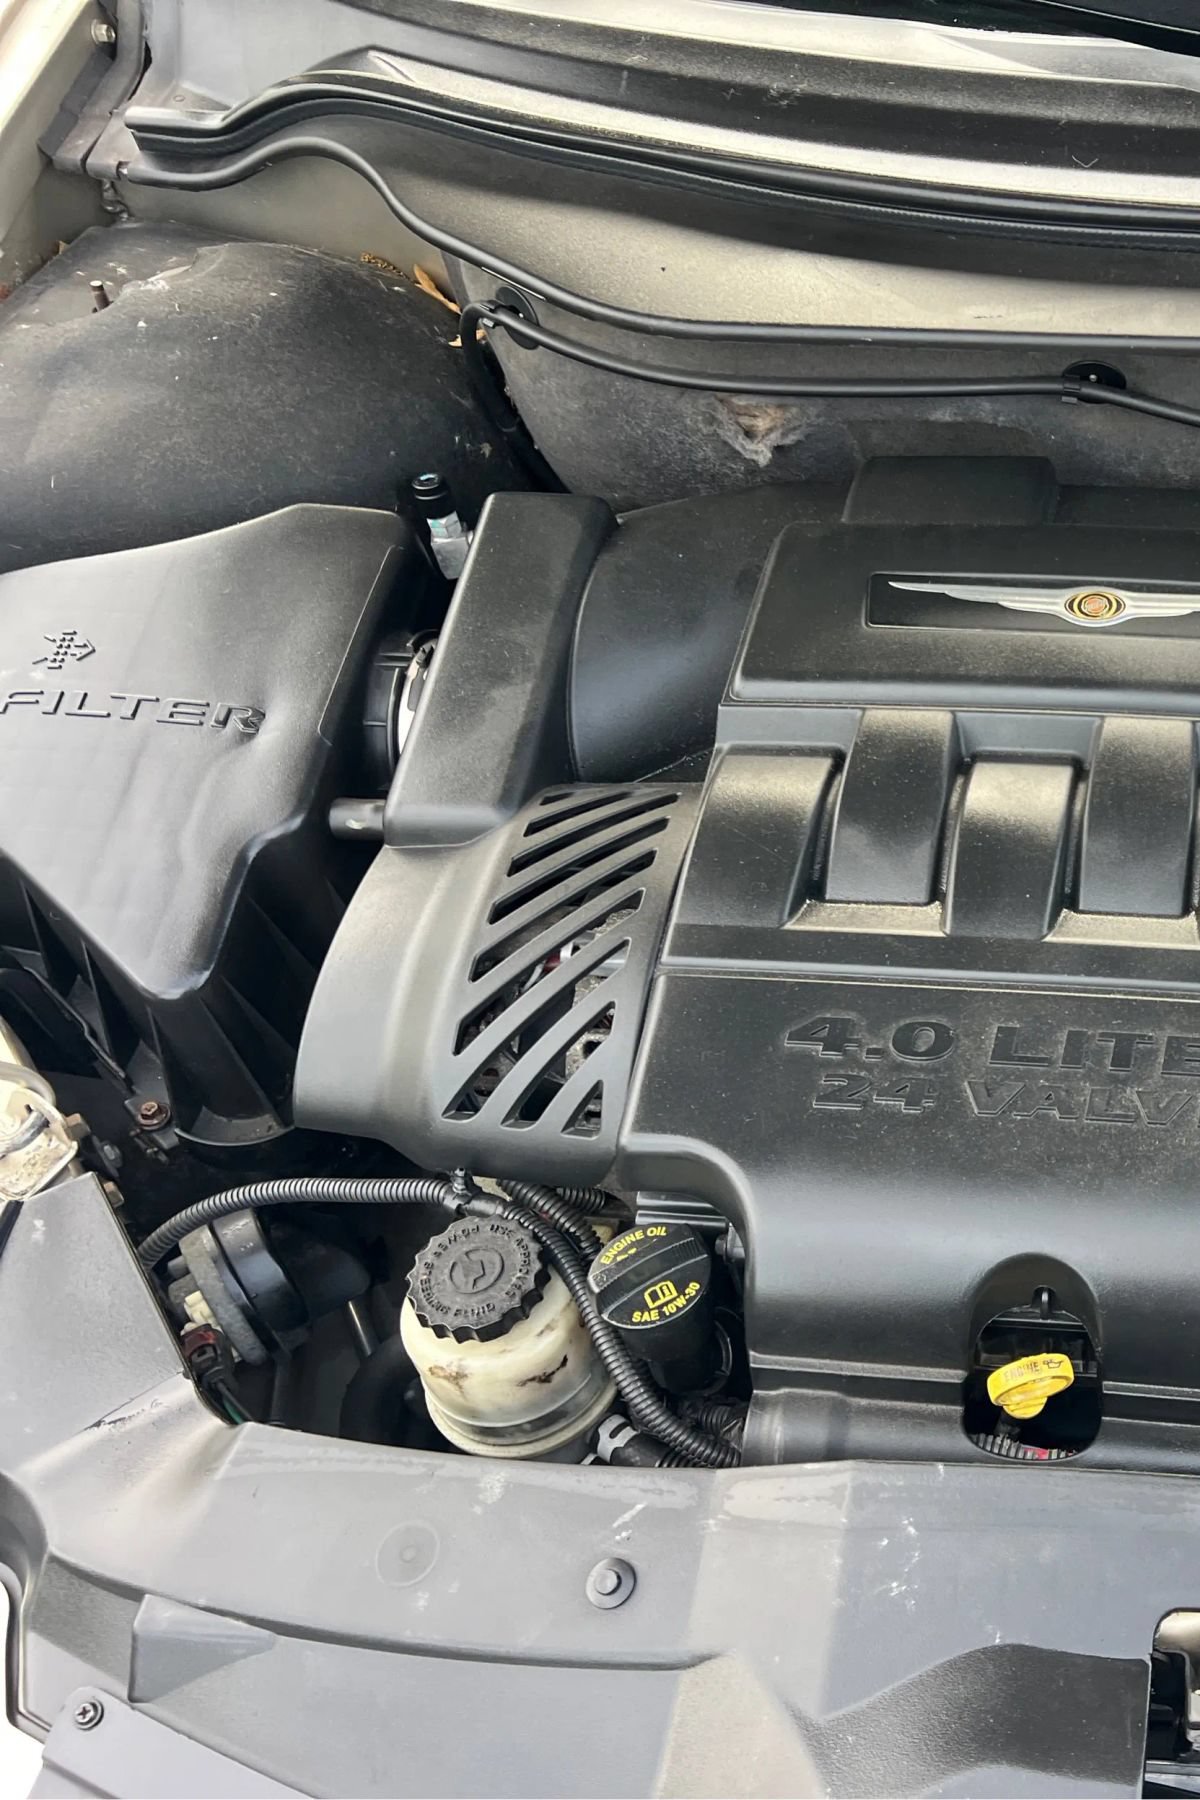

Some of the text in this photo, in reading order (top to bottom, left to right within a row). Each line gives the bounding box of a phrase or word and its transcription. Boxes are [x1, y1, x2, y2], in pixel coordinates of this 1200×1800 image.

[0, 690, 266, 733] FILTER
[785, 1014, 957, 1062] 4.0
[812, 1072, 940, 1113] 24
[600, 1226, 668, 1265] ENGINE OIL
[631, 1281, 701, 1323] SAE 10W-30
[1002, 1360, 1041, 1383] ENGINE
